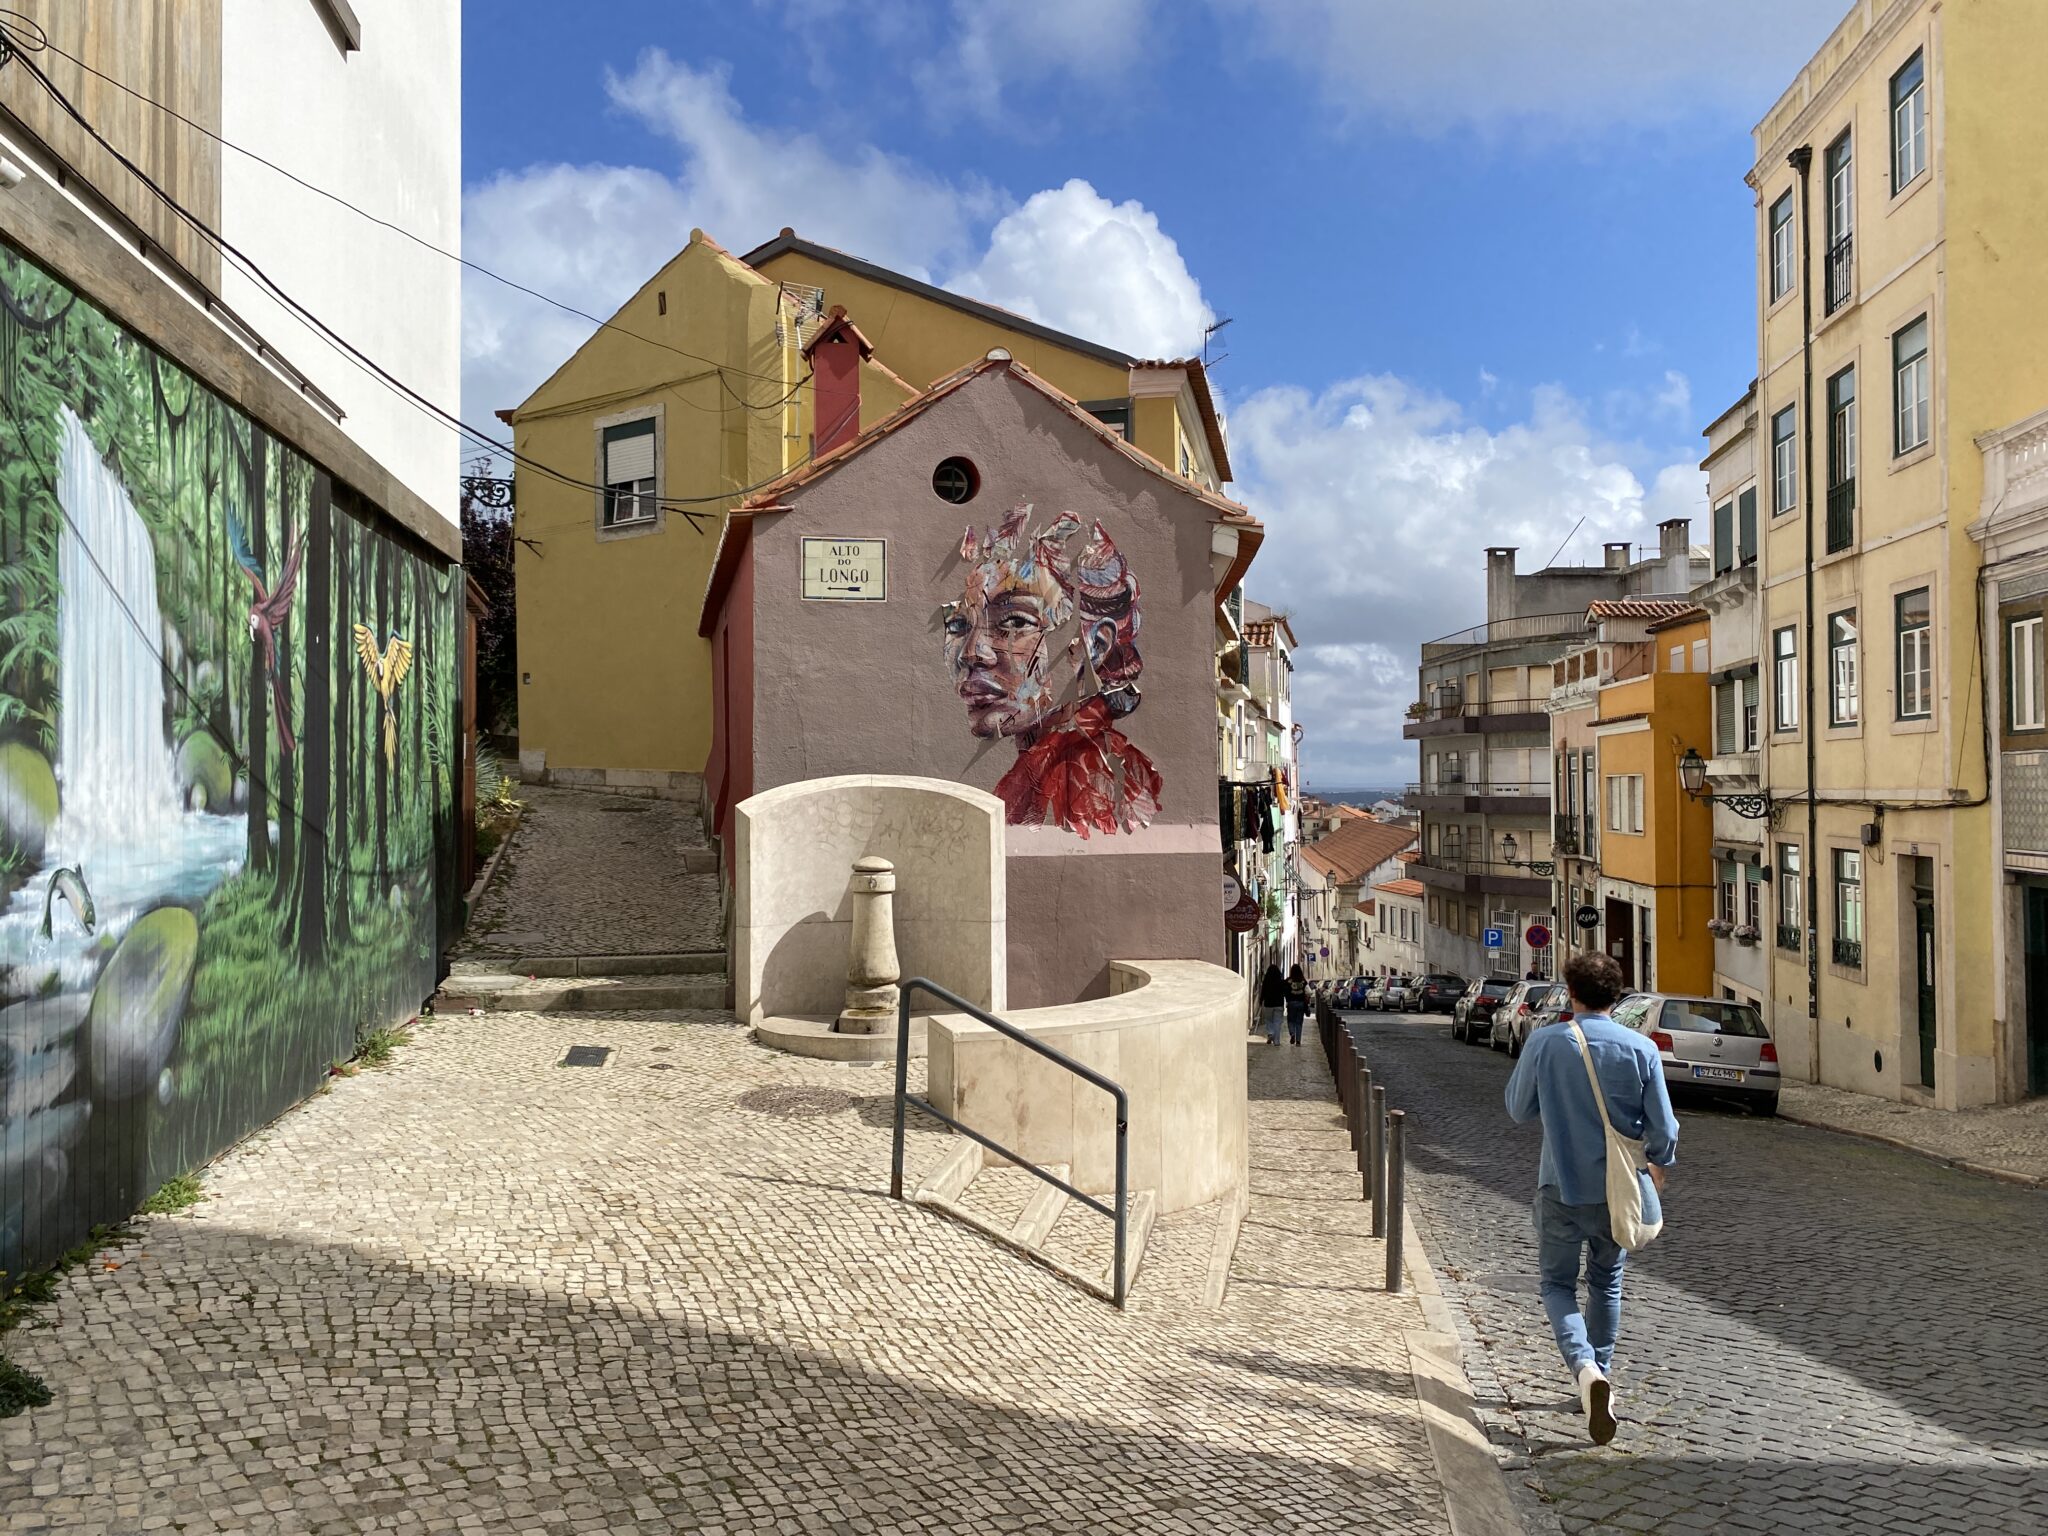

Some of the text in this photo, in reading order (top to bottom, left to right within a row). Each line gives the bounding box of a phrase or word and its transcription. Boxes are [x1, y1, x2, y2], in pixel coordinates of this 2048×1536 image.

[829, 545, 860, 556] ALTO
[820, 568, 869, 583] LONGO
[1578, 912, 1597, 922] RUA
[1488, 931, 1499, 945] P
